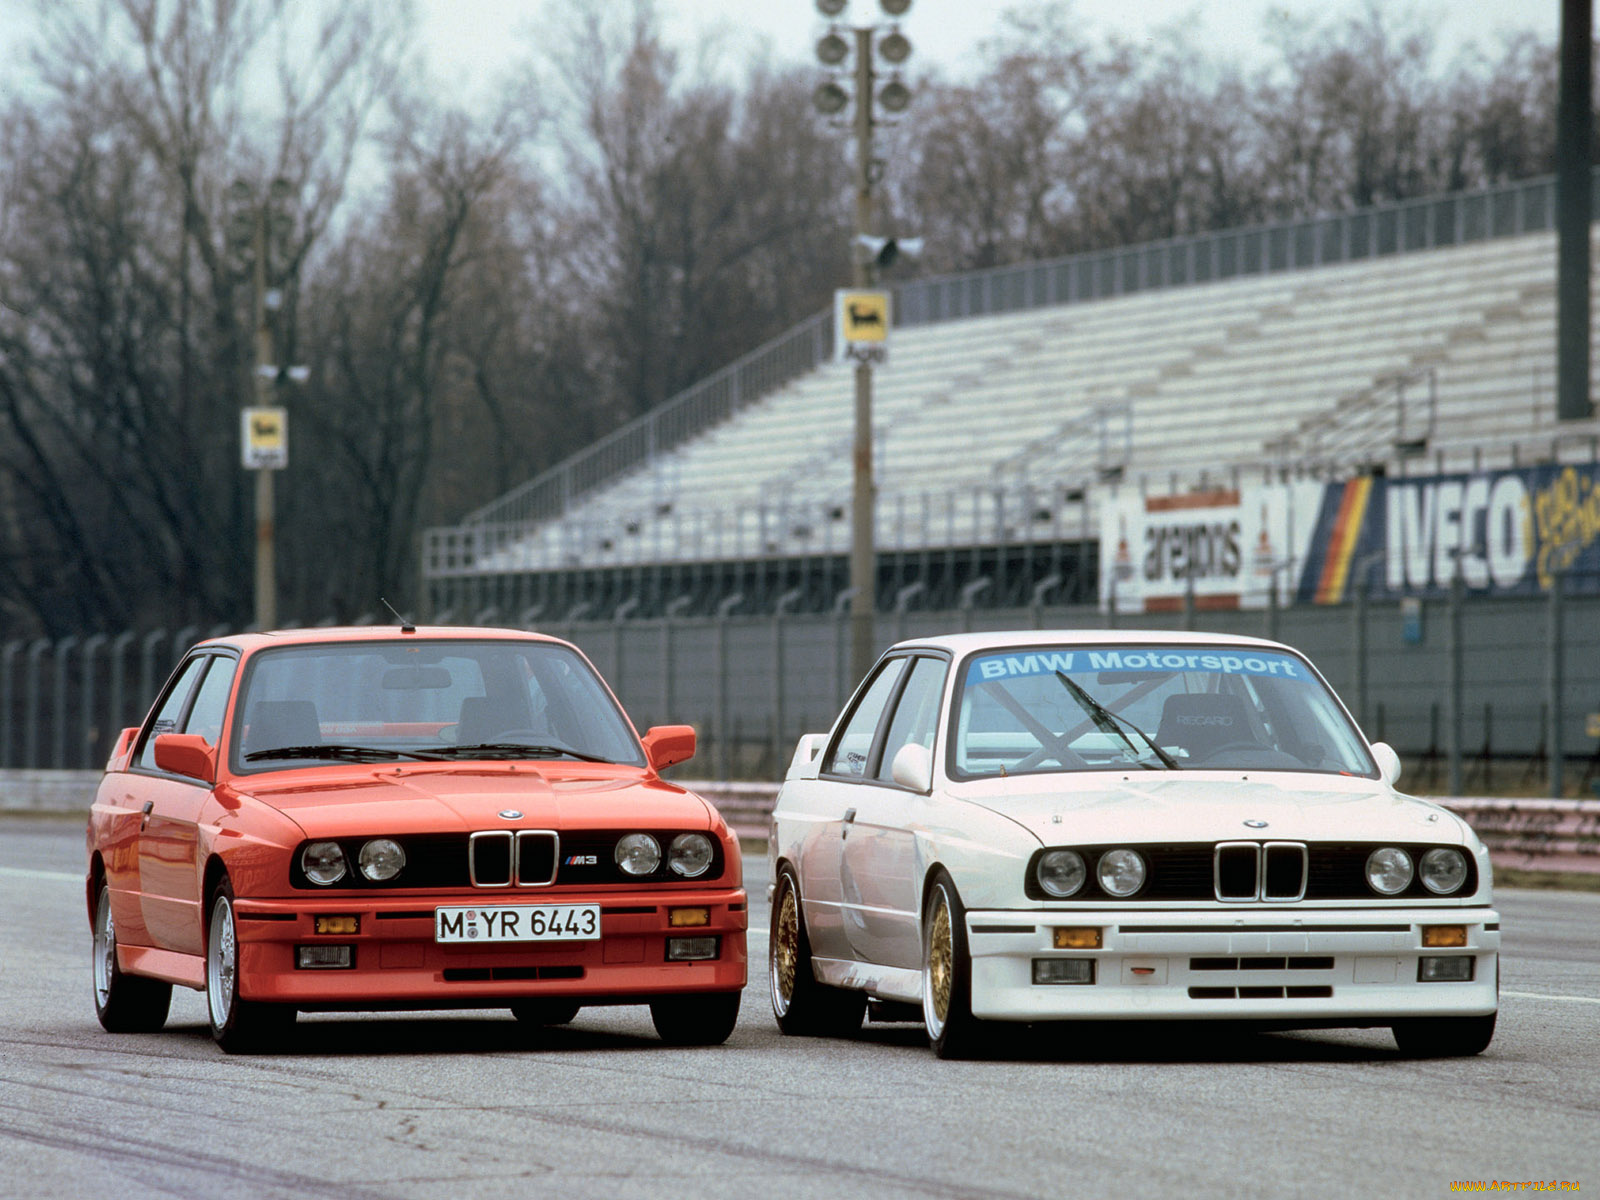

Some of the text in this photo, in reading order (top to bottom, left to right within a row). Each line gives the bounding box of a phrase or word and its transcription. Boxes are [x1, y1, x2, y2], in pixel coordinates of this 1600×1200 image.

[1386, 475, 1529, 588] IVECO
[980, 652, 1297, 678] BMW Motorsport
[573, 855, 597, 865] M3
[531, 909, 596, 936] 6443
